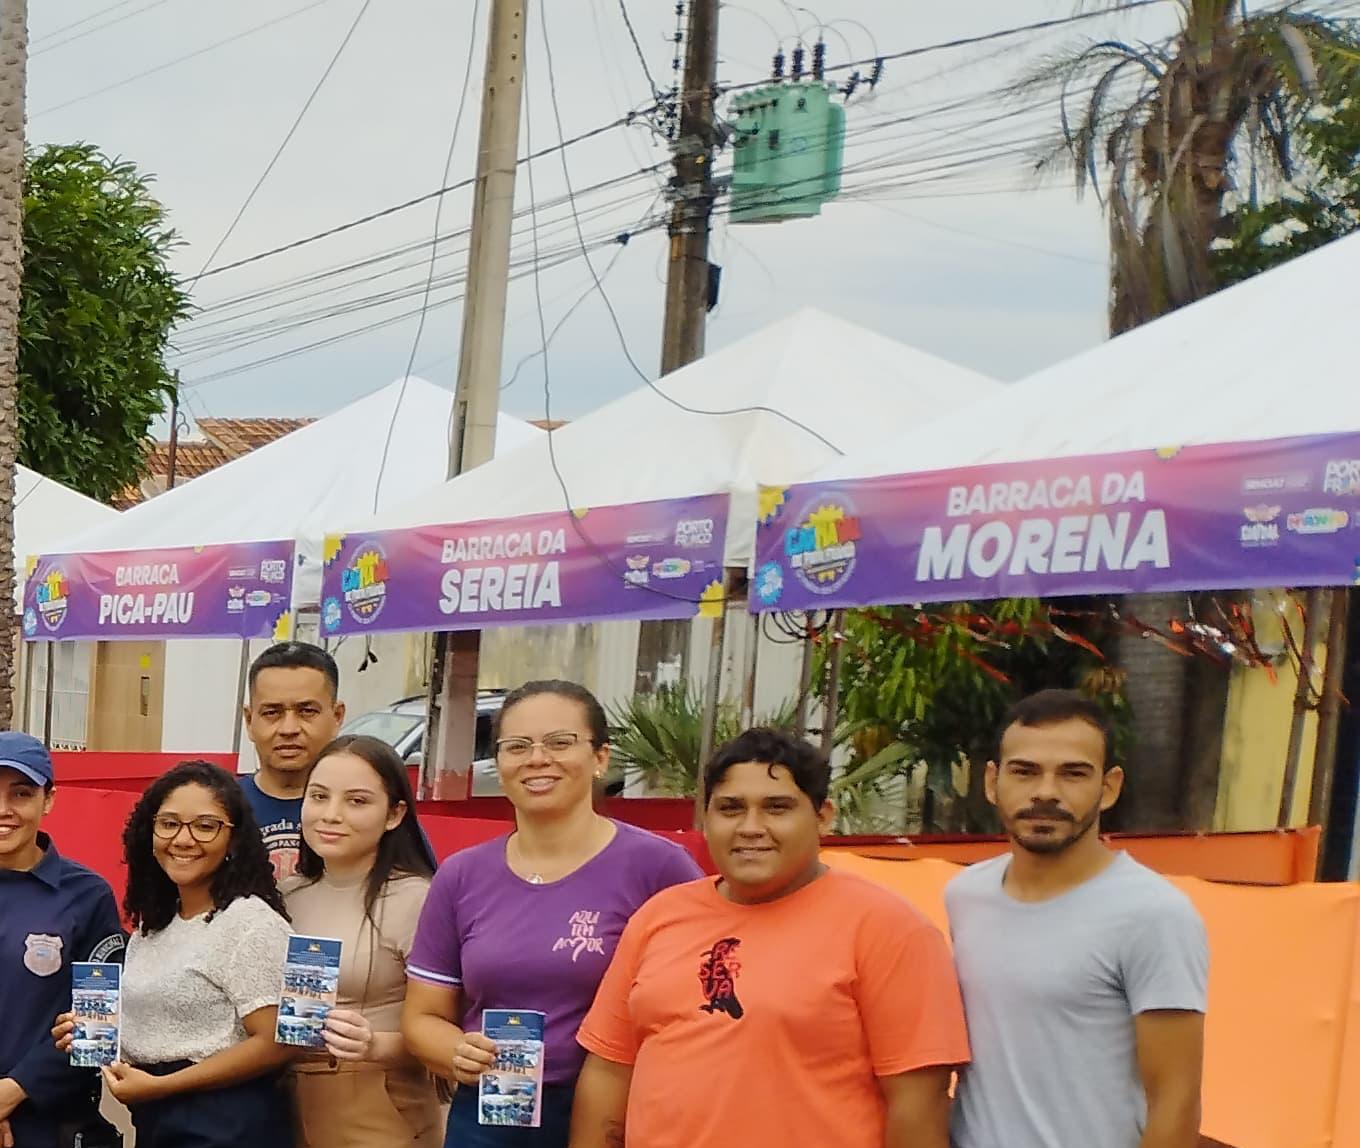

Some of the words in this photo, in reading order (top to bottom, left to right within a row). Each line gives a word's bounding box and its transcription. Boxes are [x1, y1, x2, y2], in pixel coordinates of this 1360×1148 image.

[947, 475, 1093, 517] BARRACA
[1101, 471, 1146, 504] DA
[441, 532, 532, 563] BARRACA
[537, 528, 566, 555] DA
[915, 509, 1171, 581] MORENA
[115, 564, 180, 586] BARRACA
[439, 561, 562, 614] SEREIA
[98, 592, 194, 624] PICA-PAU
